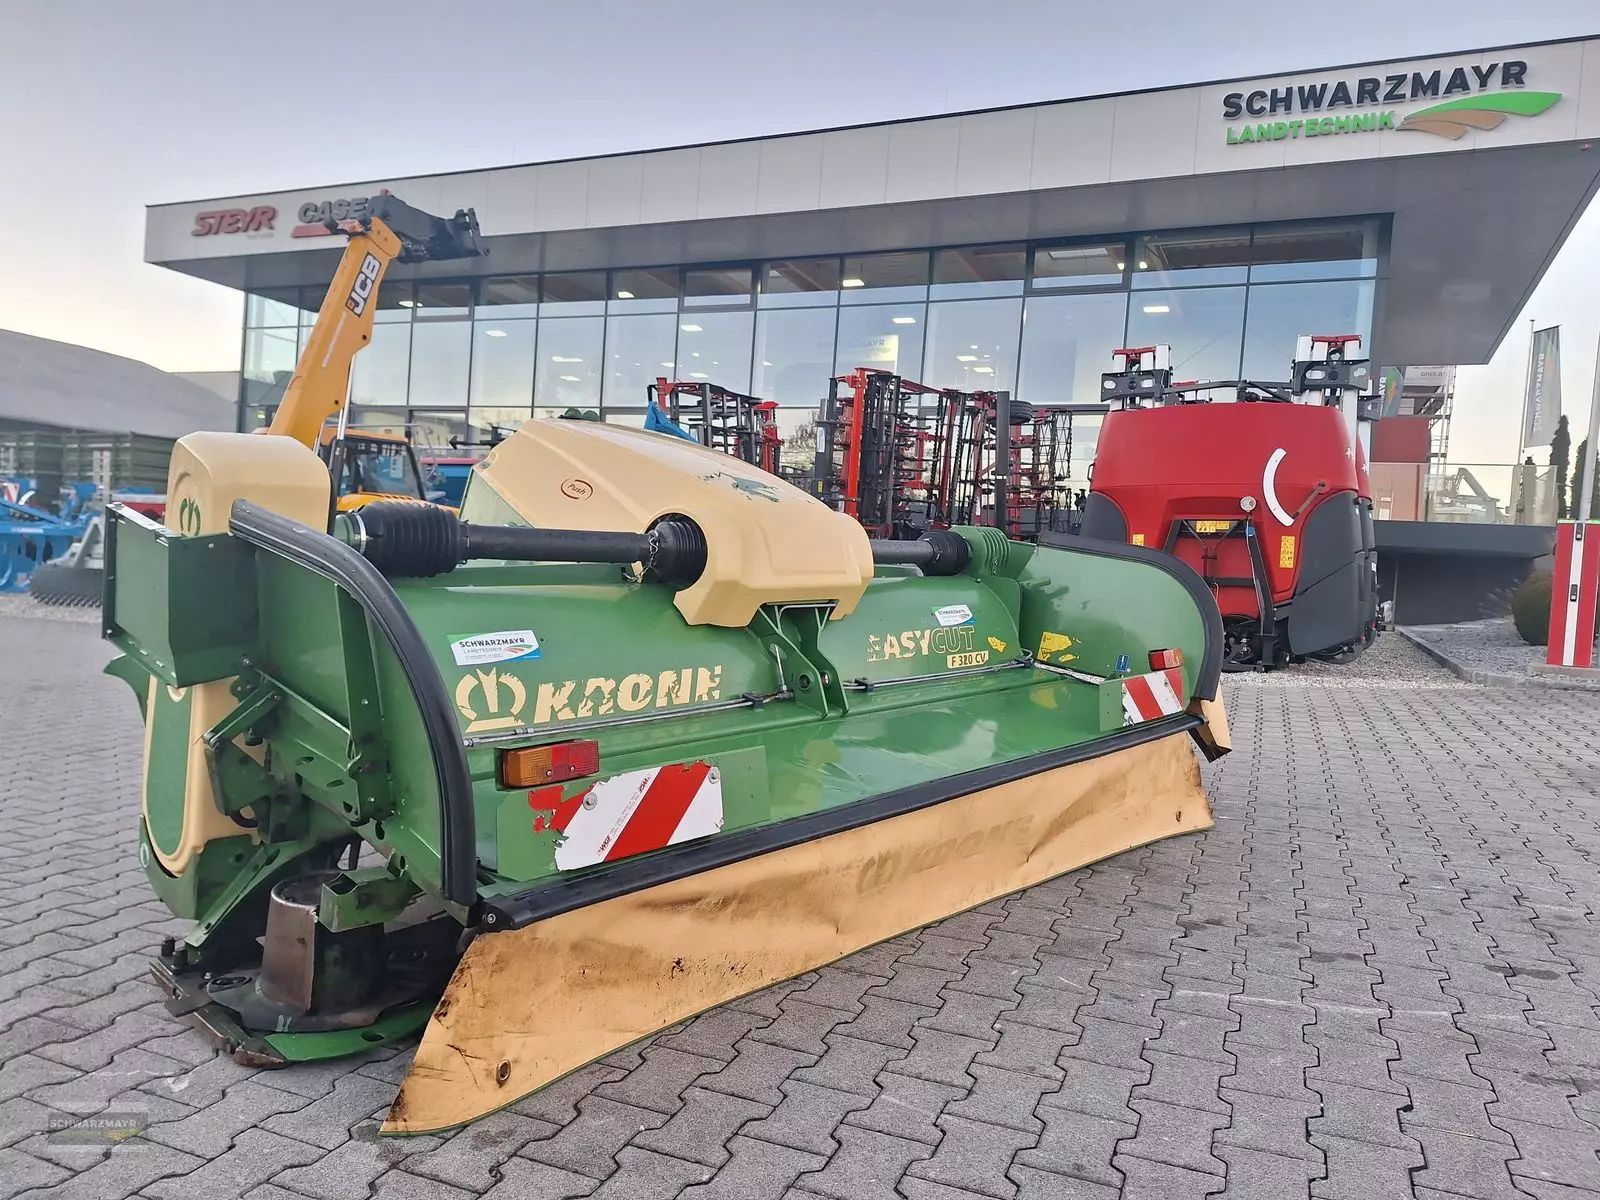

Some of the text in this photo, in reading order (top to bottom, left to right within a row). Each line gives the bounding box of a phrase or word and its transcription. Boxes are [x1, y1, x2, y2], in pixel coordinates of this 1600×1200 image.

[1222, 60, 1528, 120] SCHWARZMAYR
[1226, 110, 1395, 145] LANDTECHNIK
[191, 205, 277, 237] STEYR
[347, 253, 381, 316] JCB
[567, 483, 586, 496] Push
[459, 637, 526, 648] SCHWARZMAYR
[951, 652, 986, 667] F 320 CV
